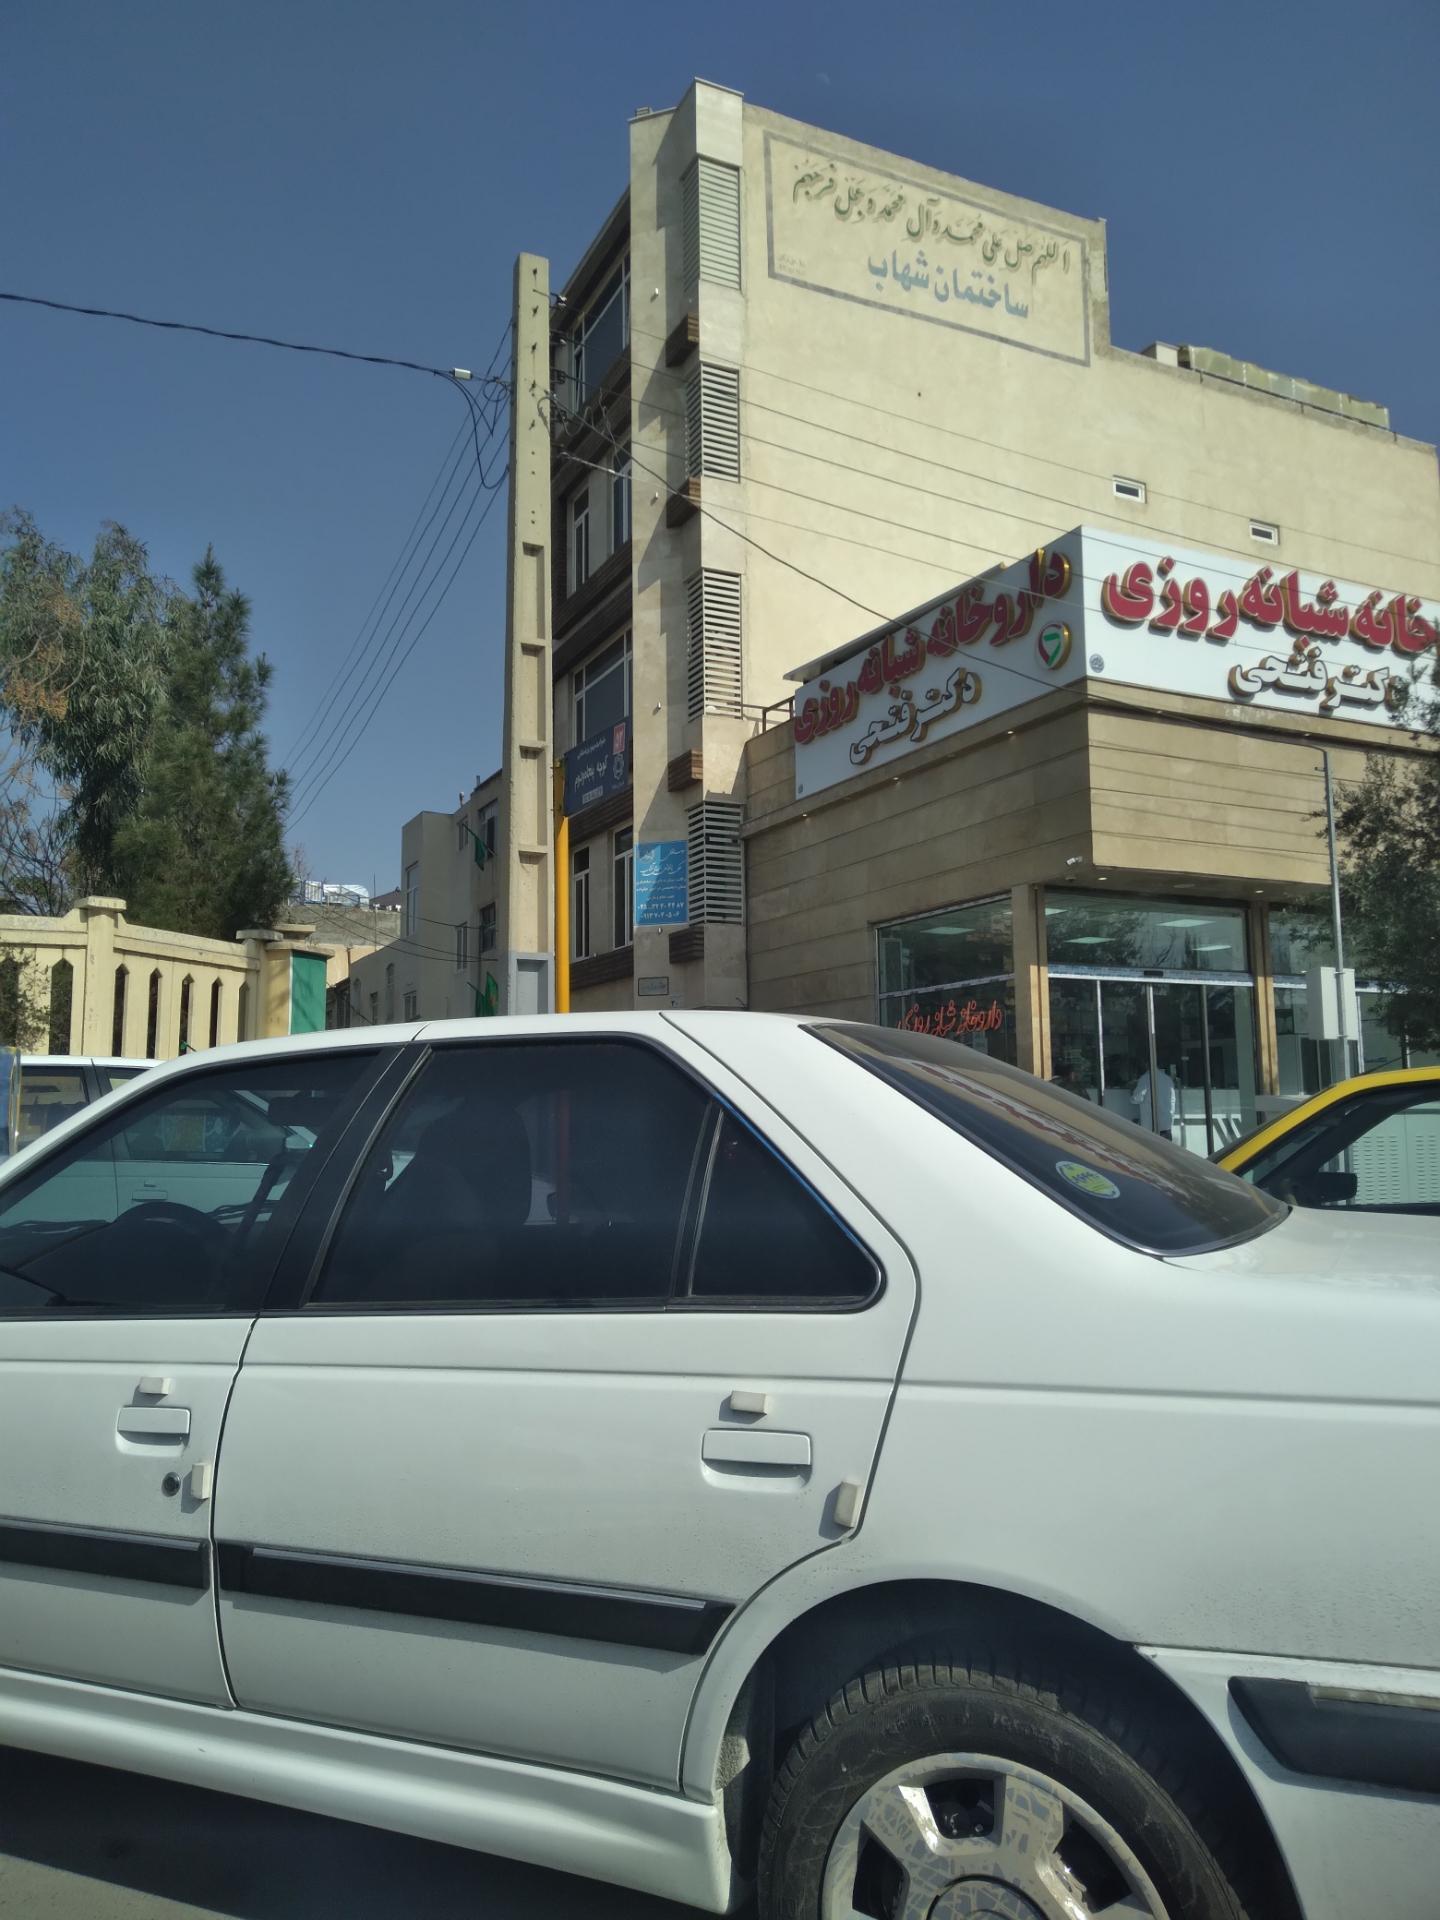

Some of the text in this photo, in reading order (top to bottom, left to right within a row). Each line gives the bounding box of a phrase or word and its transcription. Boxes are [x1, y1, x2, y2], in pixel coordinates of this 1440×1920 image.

[867, 249, 1029, 319] ساختمان شهاب
[927, 547, 1071, 657] داروخانه
[1228, 646, 1329, 698] فتحی
[849, 668, 982, 765] دکتر فتحی
